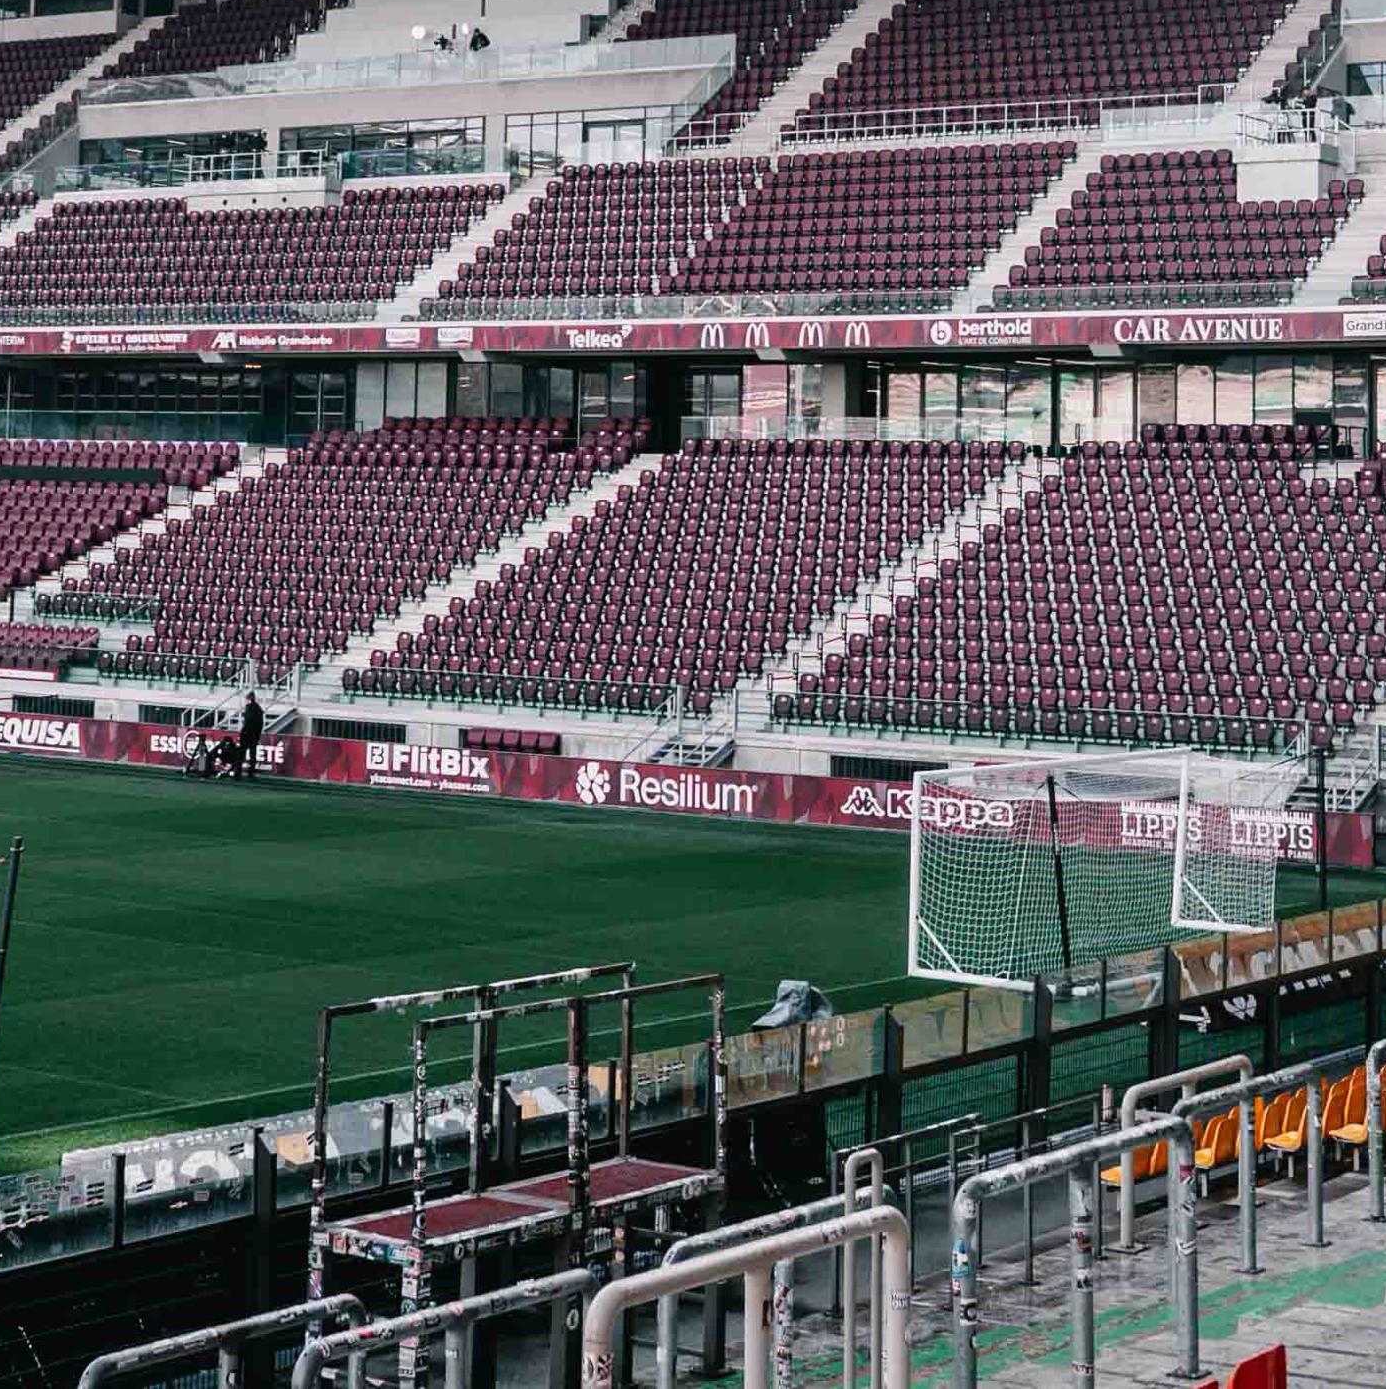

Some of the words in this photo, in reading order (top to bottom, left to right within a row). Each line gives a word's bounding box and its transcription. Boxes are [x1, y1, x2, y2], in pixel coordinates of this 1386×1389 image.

[566, 329, 622, 349] Telkea
[958, 319, 1032, 337] berthold
[1113, 318, 1171, 342] CAR
[1179, 318, 1283, 342] AVENUE
[620, 768, 753, 813] Resilium
[887, 789, 1013, 829] Kappa
[1121, 812, 1202, 842] LIPPS
[1230, 820, 1314, 850] LIPPIS
